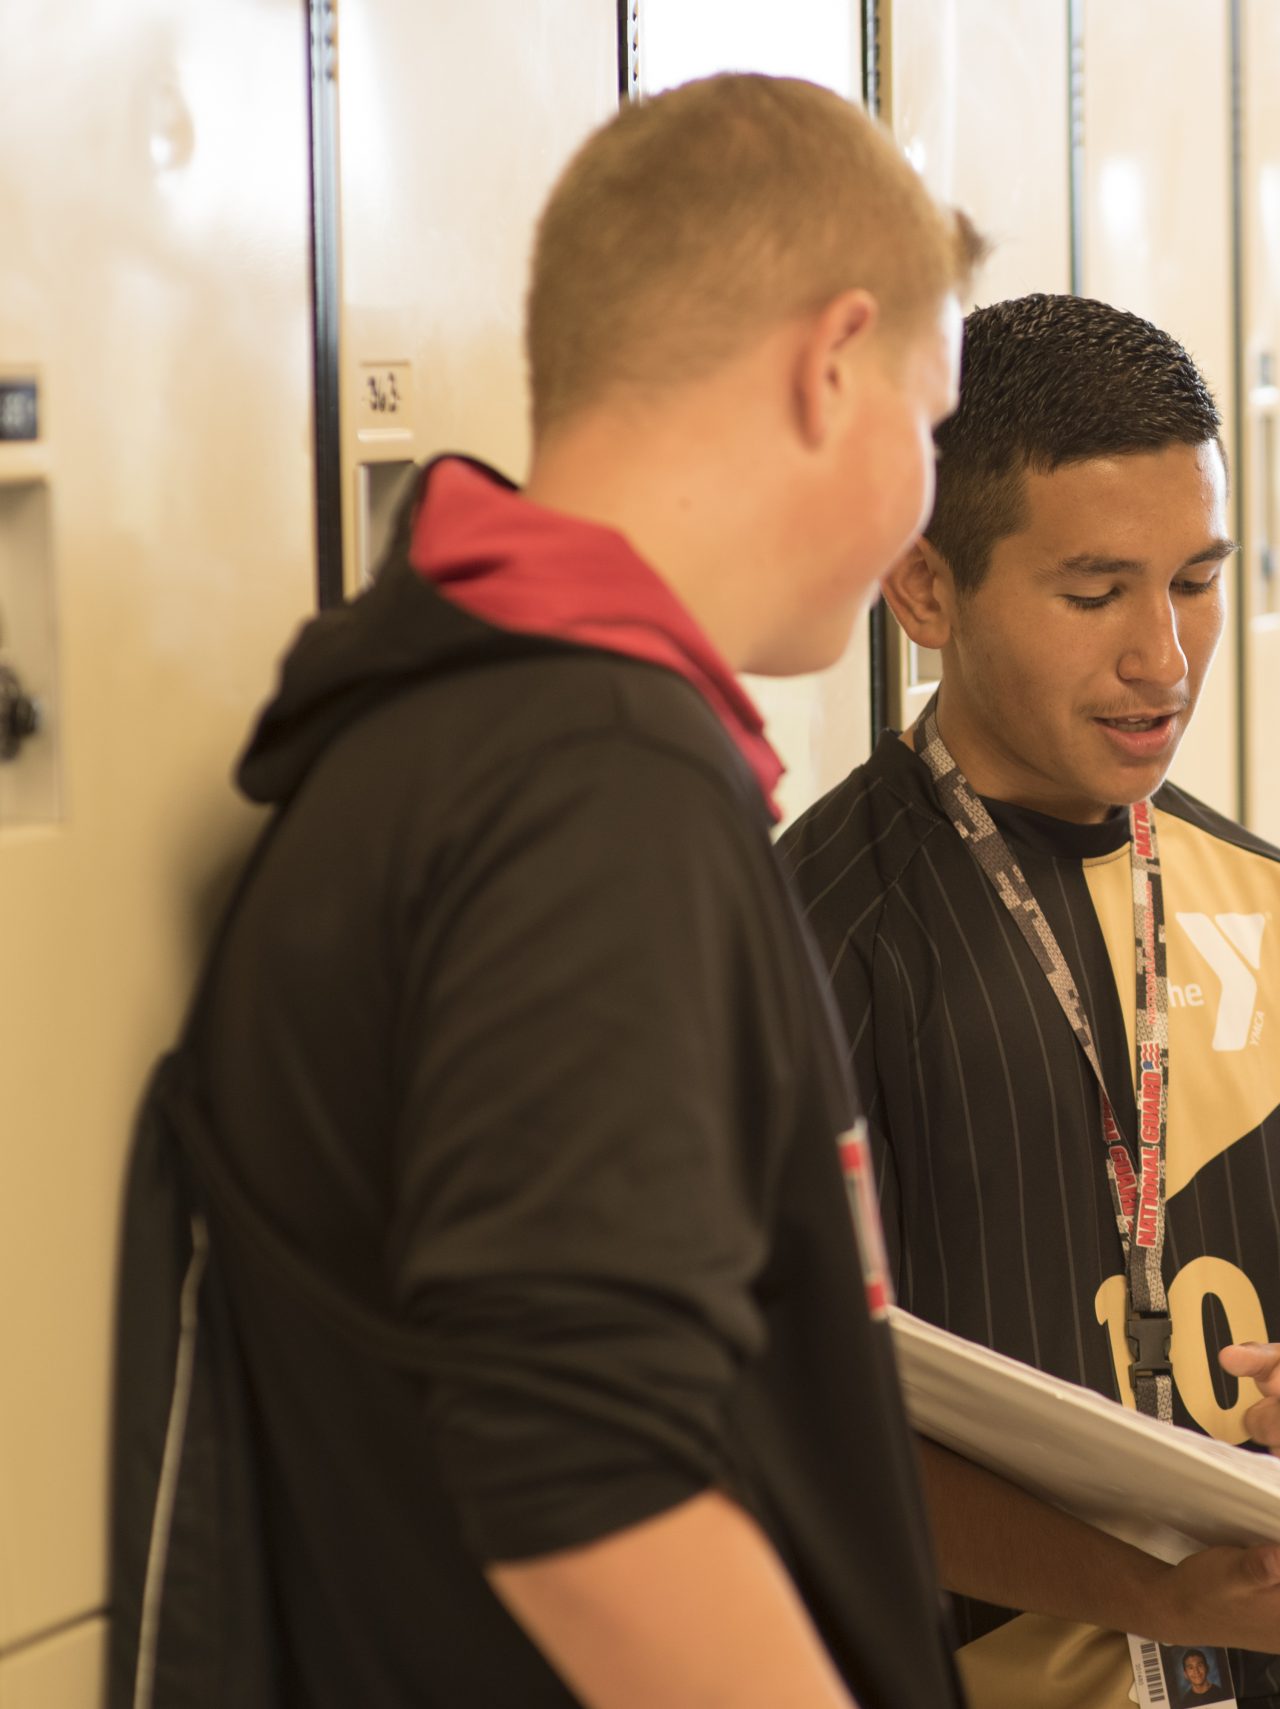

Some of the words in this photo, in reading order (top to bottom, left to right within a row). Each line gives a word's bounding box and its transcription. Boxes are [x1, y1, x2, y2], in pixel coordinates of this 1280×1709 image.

[1167, 977, 1205, 1008] he
[1249, 1010, 1265, 1046] YMCA
[1141, 1071, 1162, 1144] GUARD
[1136, 1146, 1160, 1247] NATIONAL
[1094, 1256, 1269, 1446] 10
